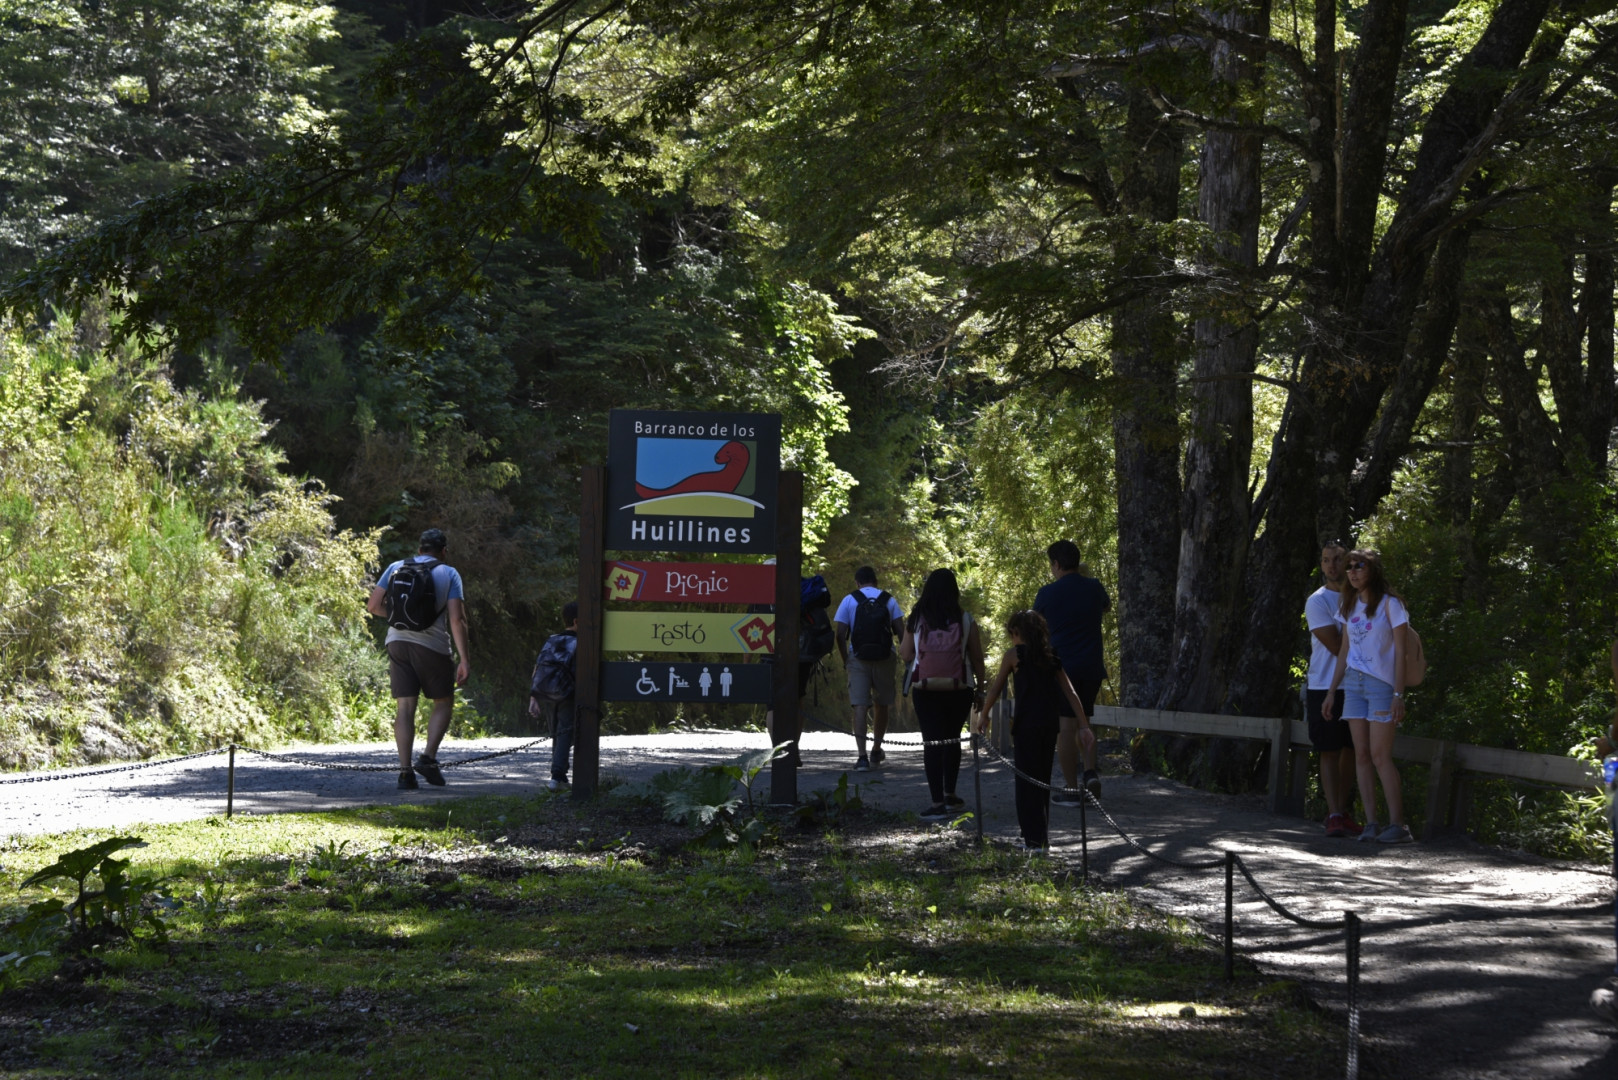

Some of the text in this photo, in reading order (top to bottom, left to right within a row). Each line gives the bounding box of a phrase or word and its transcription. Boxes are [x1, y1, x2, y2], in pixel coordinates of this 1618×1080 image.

[635, 421, 755, 437] Barranco de los
[631, 520, 751, 544] Huillines
[665, 570, 729, 597] picnic
[651, 620, 706, 646] restó
